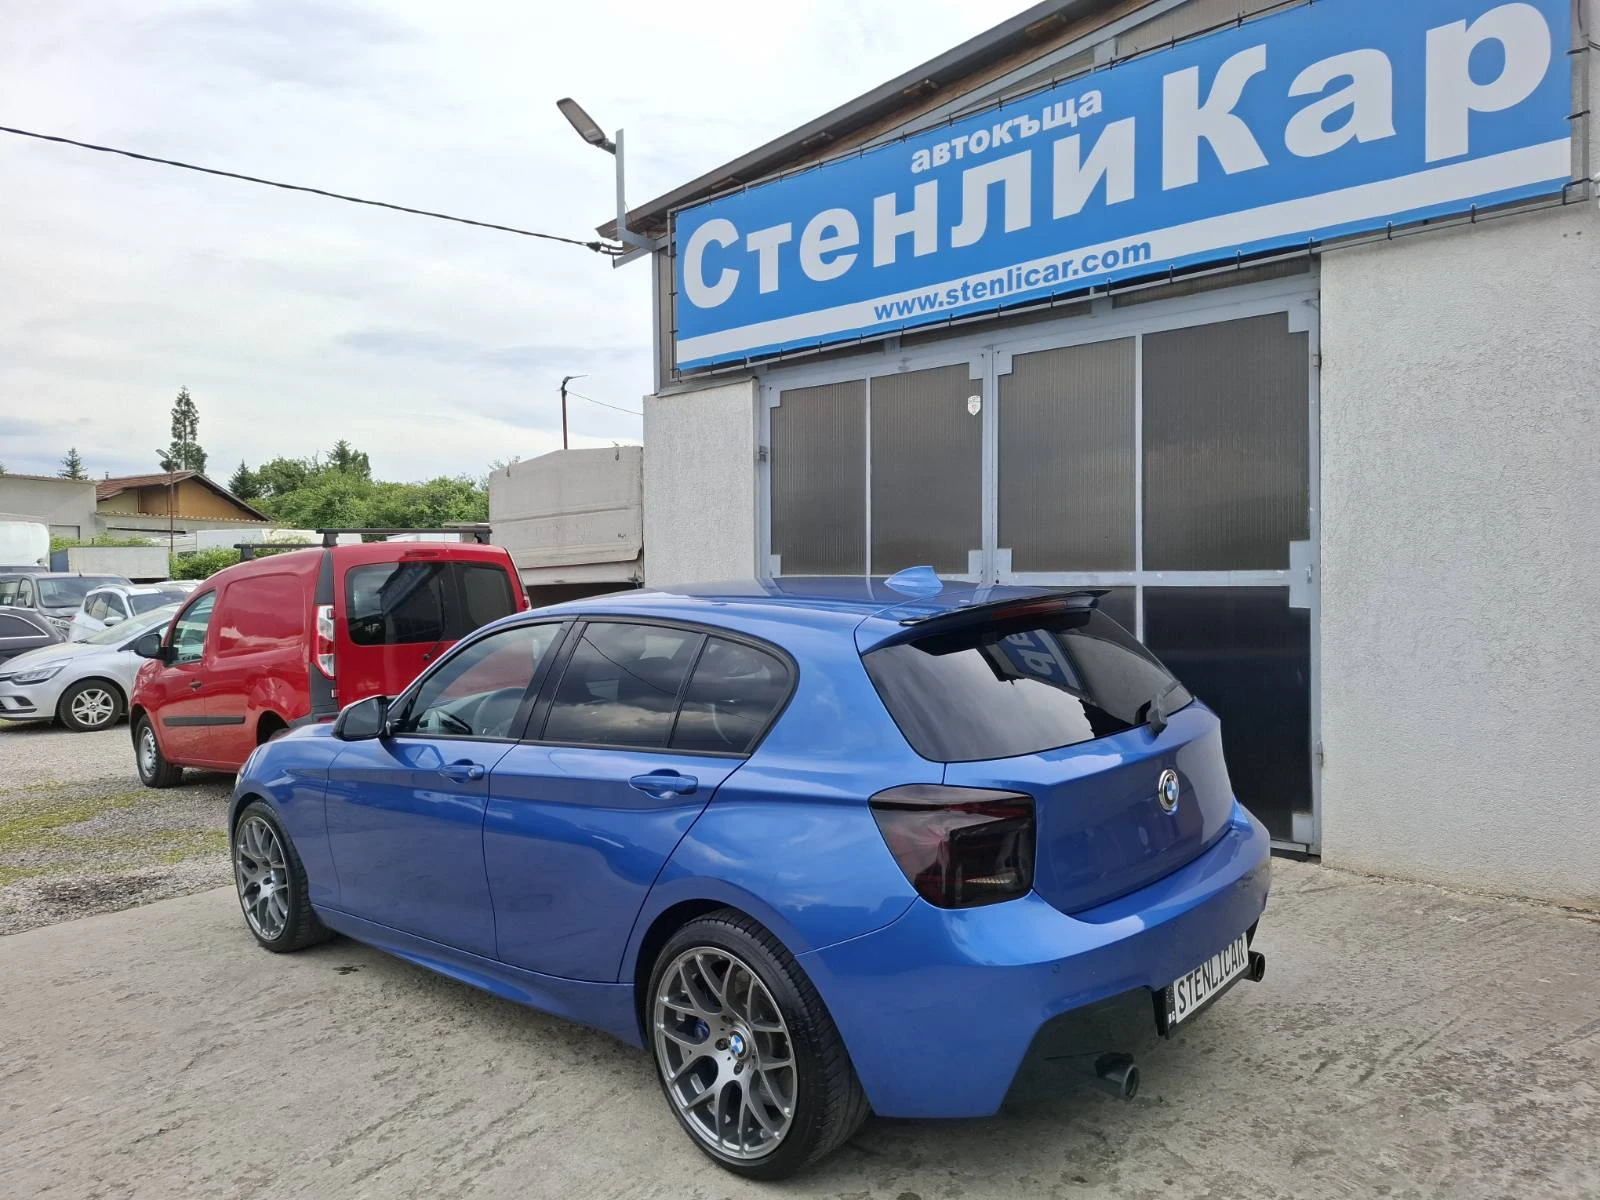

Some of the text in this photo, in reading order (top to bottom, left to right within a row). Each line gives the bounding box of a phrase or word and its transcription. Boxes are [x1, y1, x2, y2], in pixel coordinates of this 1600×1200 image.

[911, 89, 1102, 174] автокъща
[874, 241, 1151, 320] www.stenlicar.com
[1177, 935, 1245, 1014] STENLICAR
